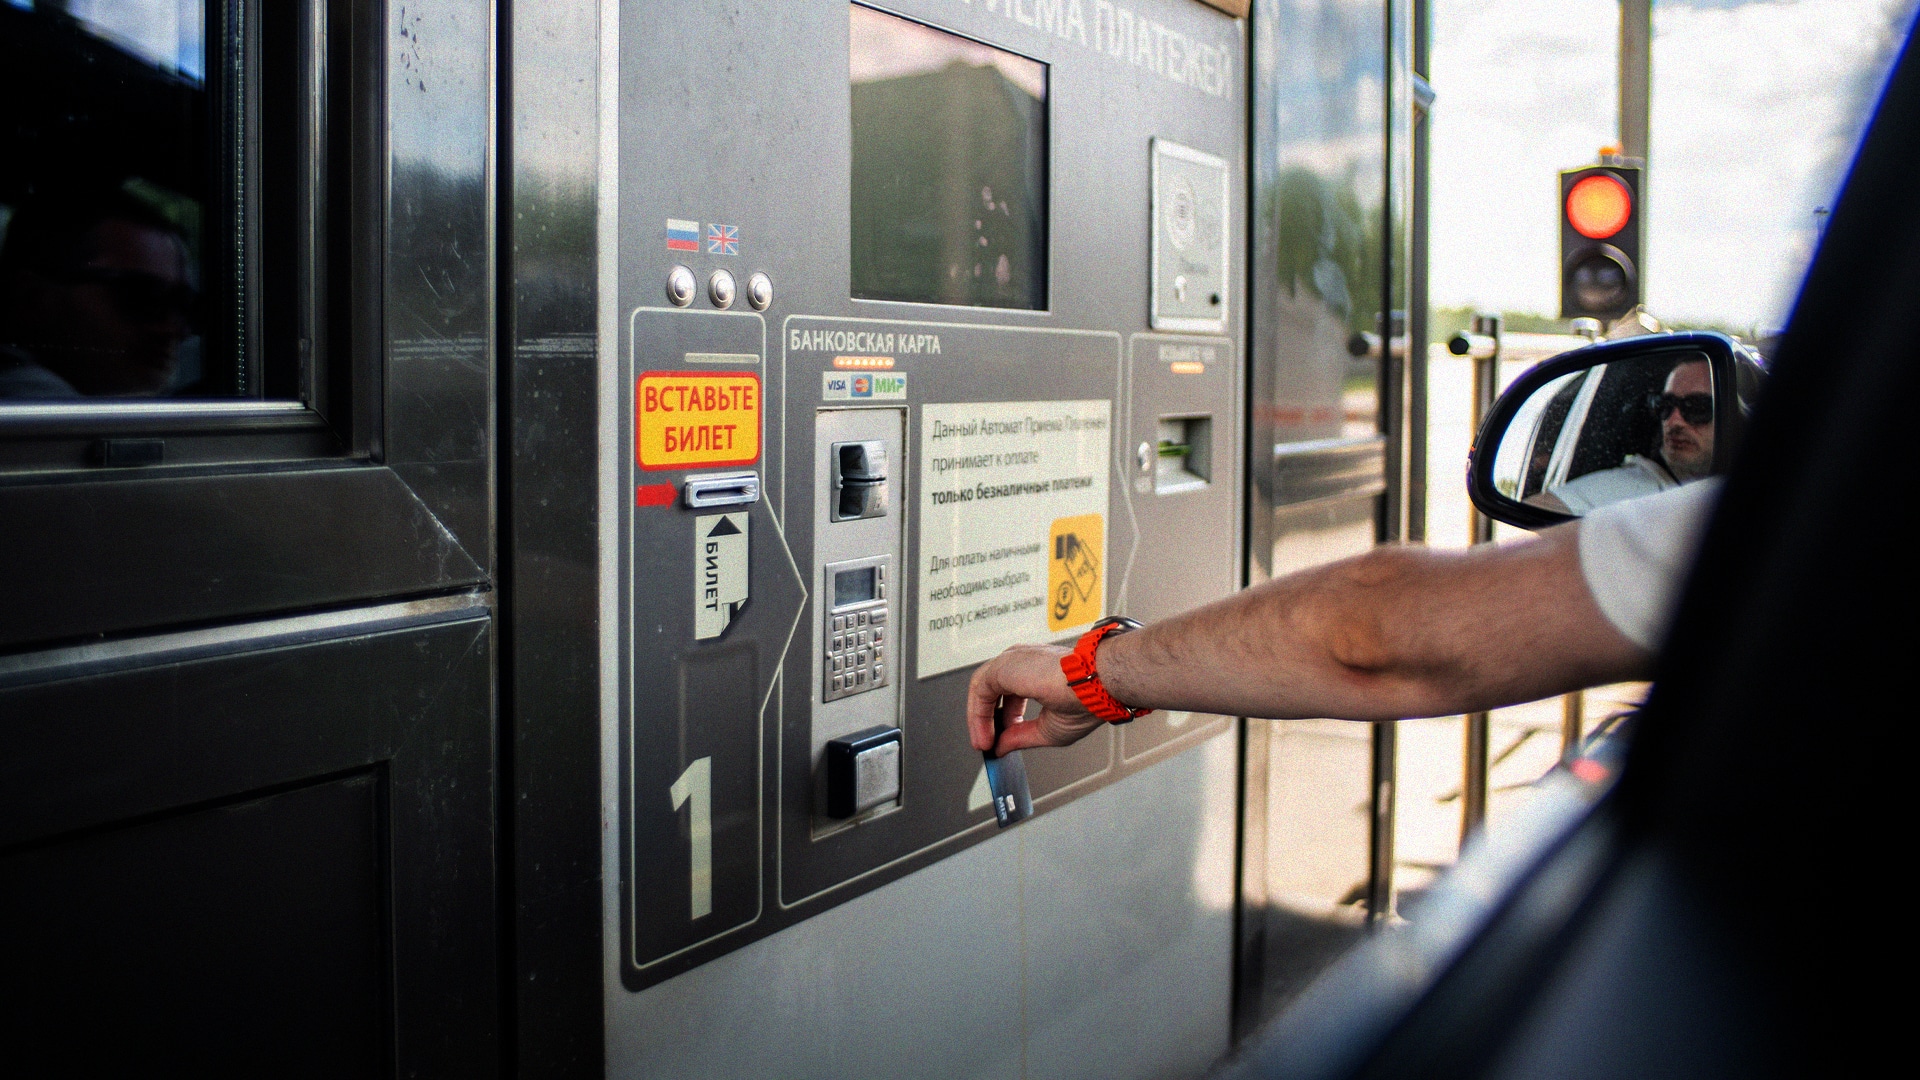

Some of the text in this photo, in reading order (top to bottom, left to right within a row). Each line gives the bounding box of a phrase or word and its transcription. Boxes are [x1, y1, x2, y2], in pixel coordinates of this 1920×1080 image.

[790, 328, 942, 355] БАНКОВСКАЯ КАРТА
[827, 379, 846, 391] VISA
[875, 378, 905, 393] МИР
[645, 385, 754, 412] ВСТАВЬТЕ
[665, 424, 737, 453] БИЛЕТ
[932, 418, 978, 440] Данный
[979, 417, 1024, 436] Автомат
[932, 452, 995, 475] принимает
[931, 487, 974, 505] только
[976, 481, 1050, 500] безналичные
[929, 555, 949, 575] Для
[952, 550, 988, 569] оплаты
[705, 541, 719, 611] БИЛЕТ
[929, 578, 990, 602] необходимо
[929, 611, 965, 631] полосу
[670, 755, 712, 921] 1
